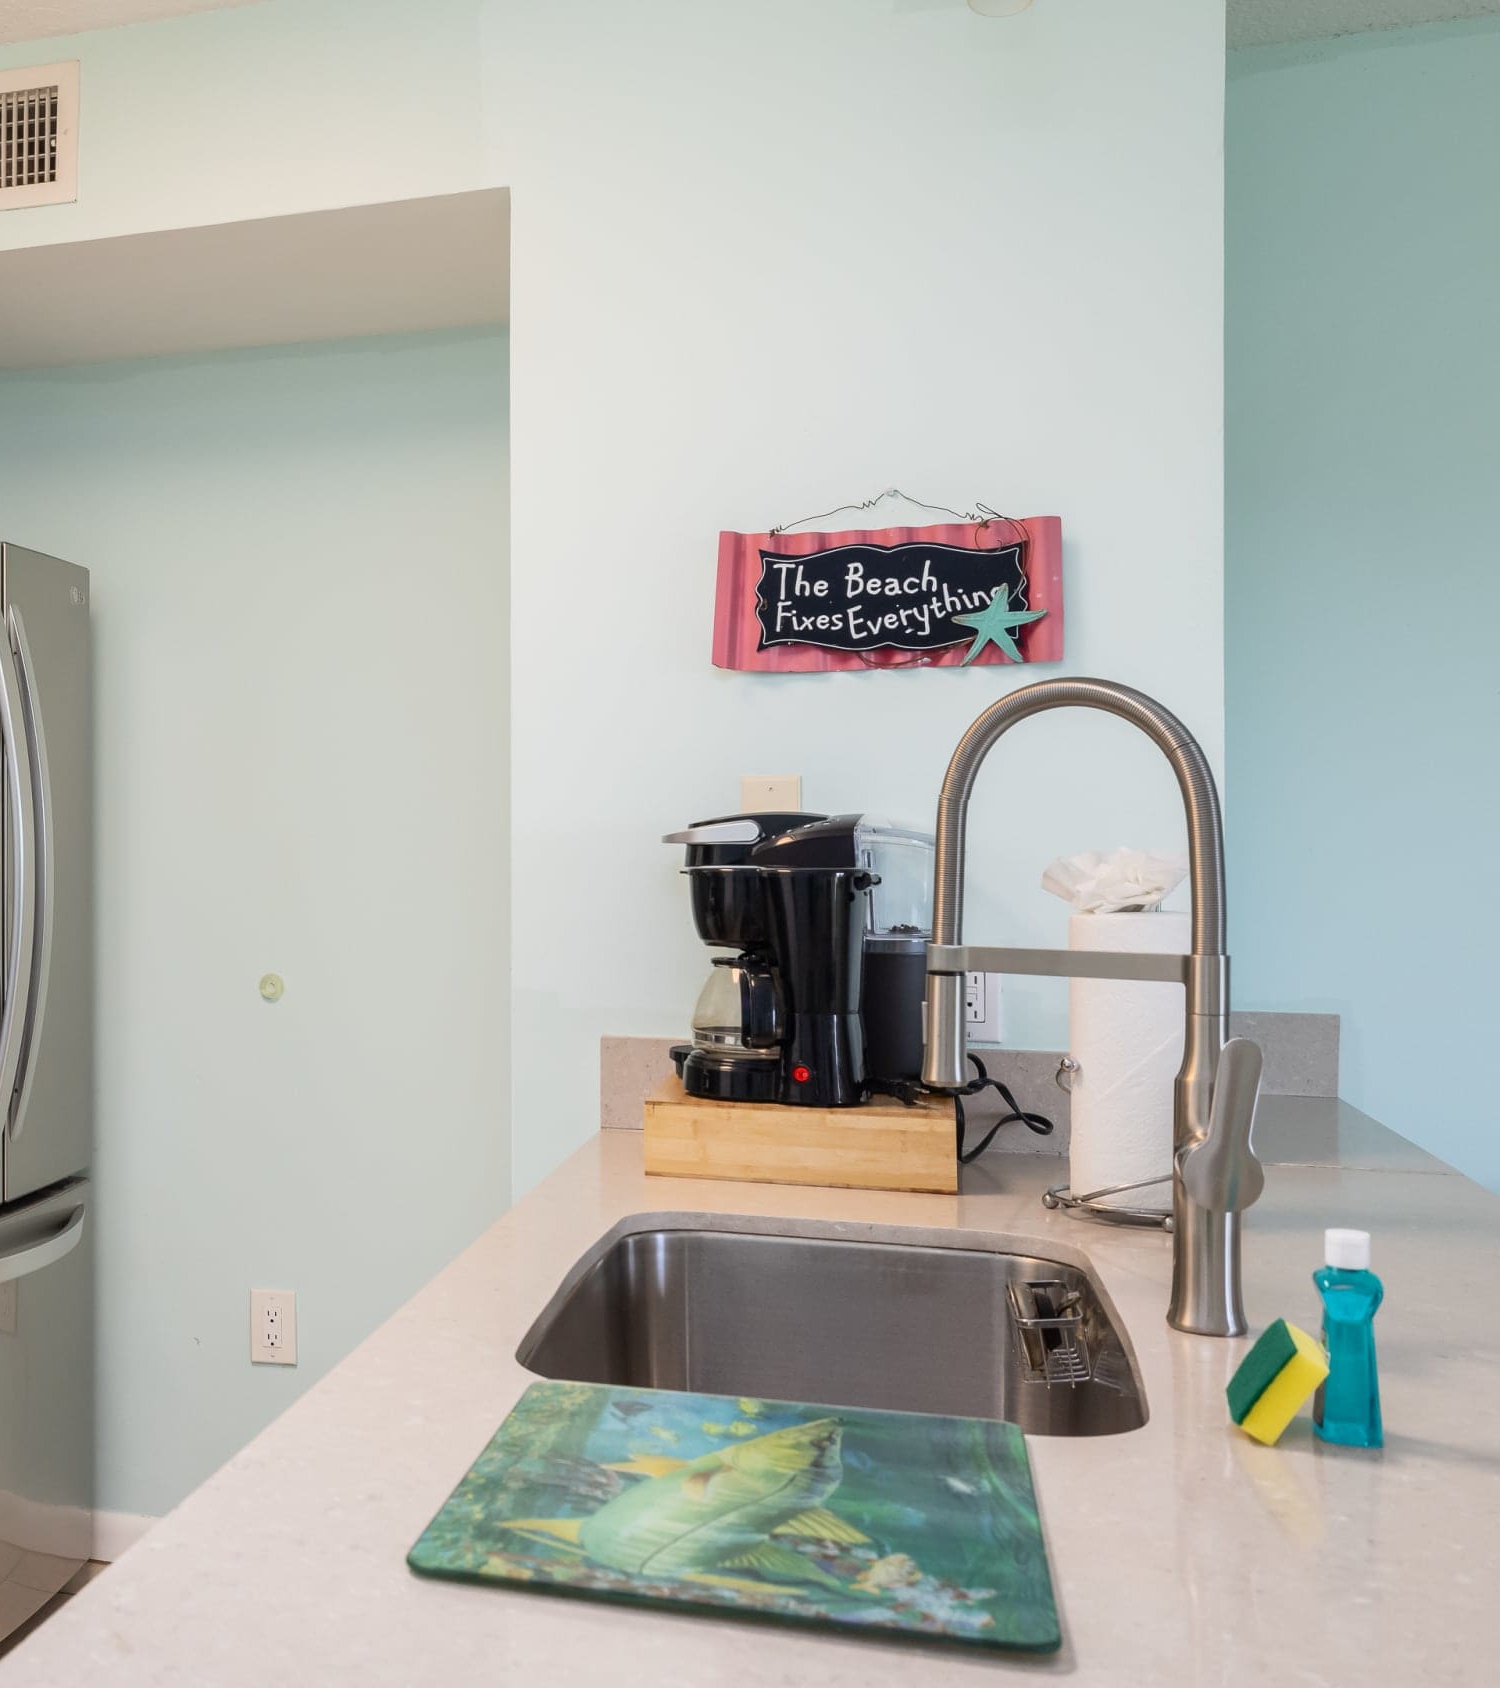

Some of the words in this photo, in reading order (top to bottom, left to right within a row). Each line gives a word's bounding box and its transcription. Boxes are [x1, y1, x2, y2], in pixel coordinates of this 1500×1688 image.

[773, 563, 829, 600] The
[844, 560, 938, 598] Beach
[775, 601, 844, 632] Fixes
